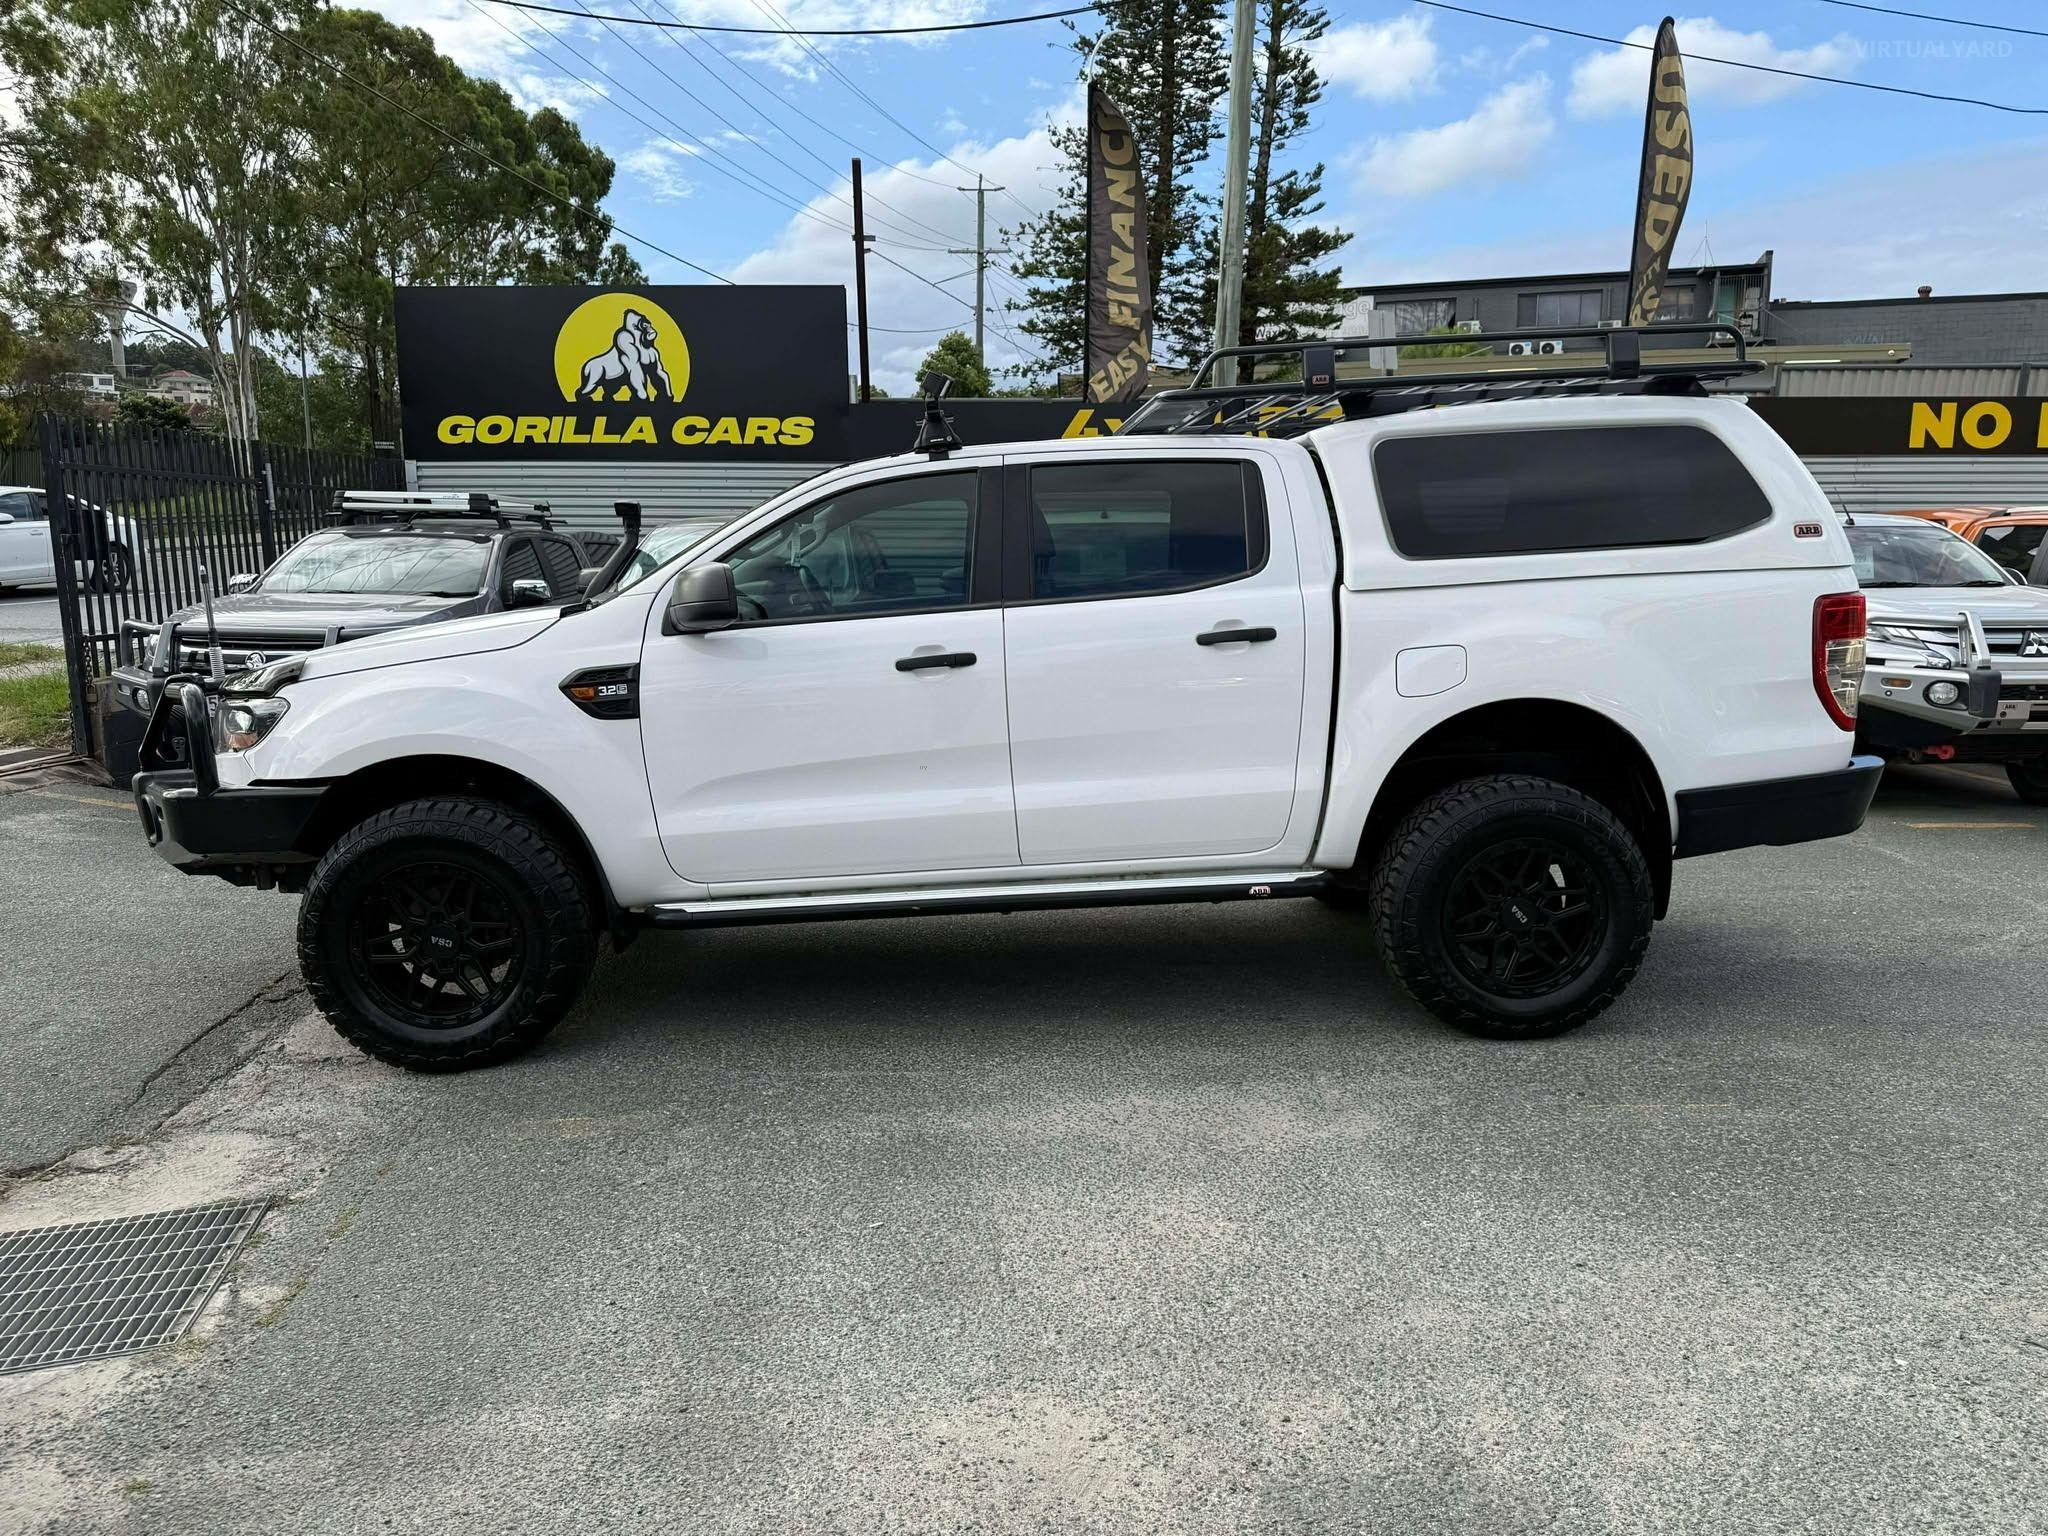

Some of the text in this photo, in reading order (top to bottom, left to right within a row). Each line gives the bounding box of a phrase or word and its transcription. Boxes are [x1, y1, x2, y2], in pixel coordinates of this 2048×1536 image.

[1645, 55, 1692, 253] USED
[1088, 329, 1151, 403] EASY
[437, 415, 815, 446] GORILLA CARS
[1908, 401, 2013, 449] NO
[1797, 526, 1820, 535] ARB
